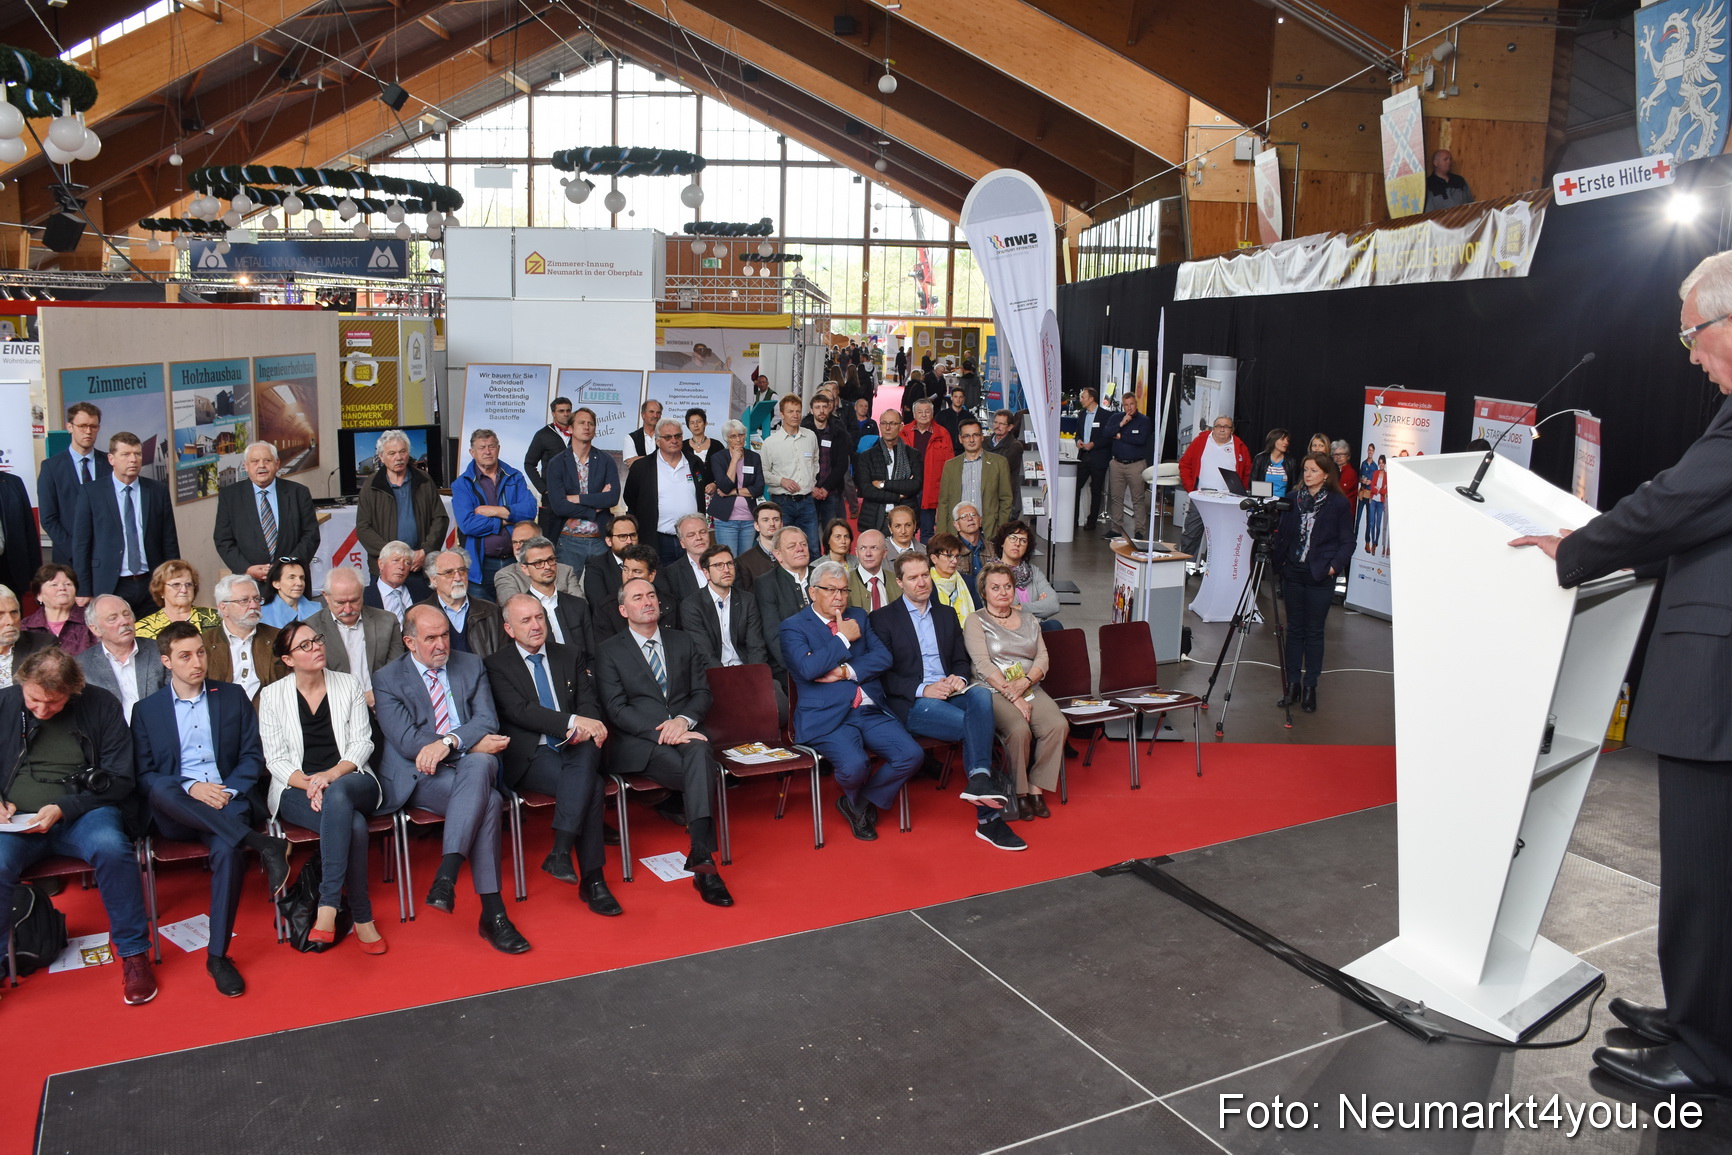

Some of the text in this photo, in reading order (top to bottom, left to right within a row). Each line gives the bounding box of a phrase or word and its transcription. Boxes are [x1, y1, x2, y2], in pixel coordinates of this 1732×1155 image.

[1578, 165, 1652, 194] Erste Hilfe
[309, 256, 360, 268] NEUMARKT
[547, 260, 615, 268] Zimmerer-Innung
[607, 269, 643, 277] Oberpfalz
[181, 366, 242, 385] Holzhausbau
[258, 360, 314, 381] Ingenieurholzbau
[87, 371, 148, 394] Zimmerei
[483, 393, 530, 401] Wertbeständig
[583, 391, 620, 400] LUBER
[346, 403, 393, 411] NEUMARKTER
[342, 412, 382, 420] HANDWERK
[1383, 414, 1411, 426] STARKE
[1411, 417, 1431, 428] JOBS
[1507, 432, 1523, 444] JOBS
[1232, 534, 1244, 580] starke-jobs.de
